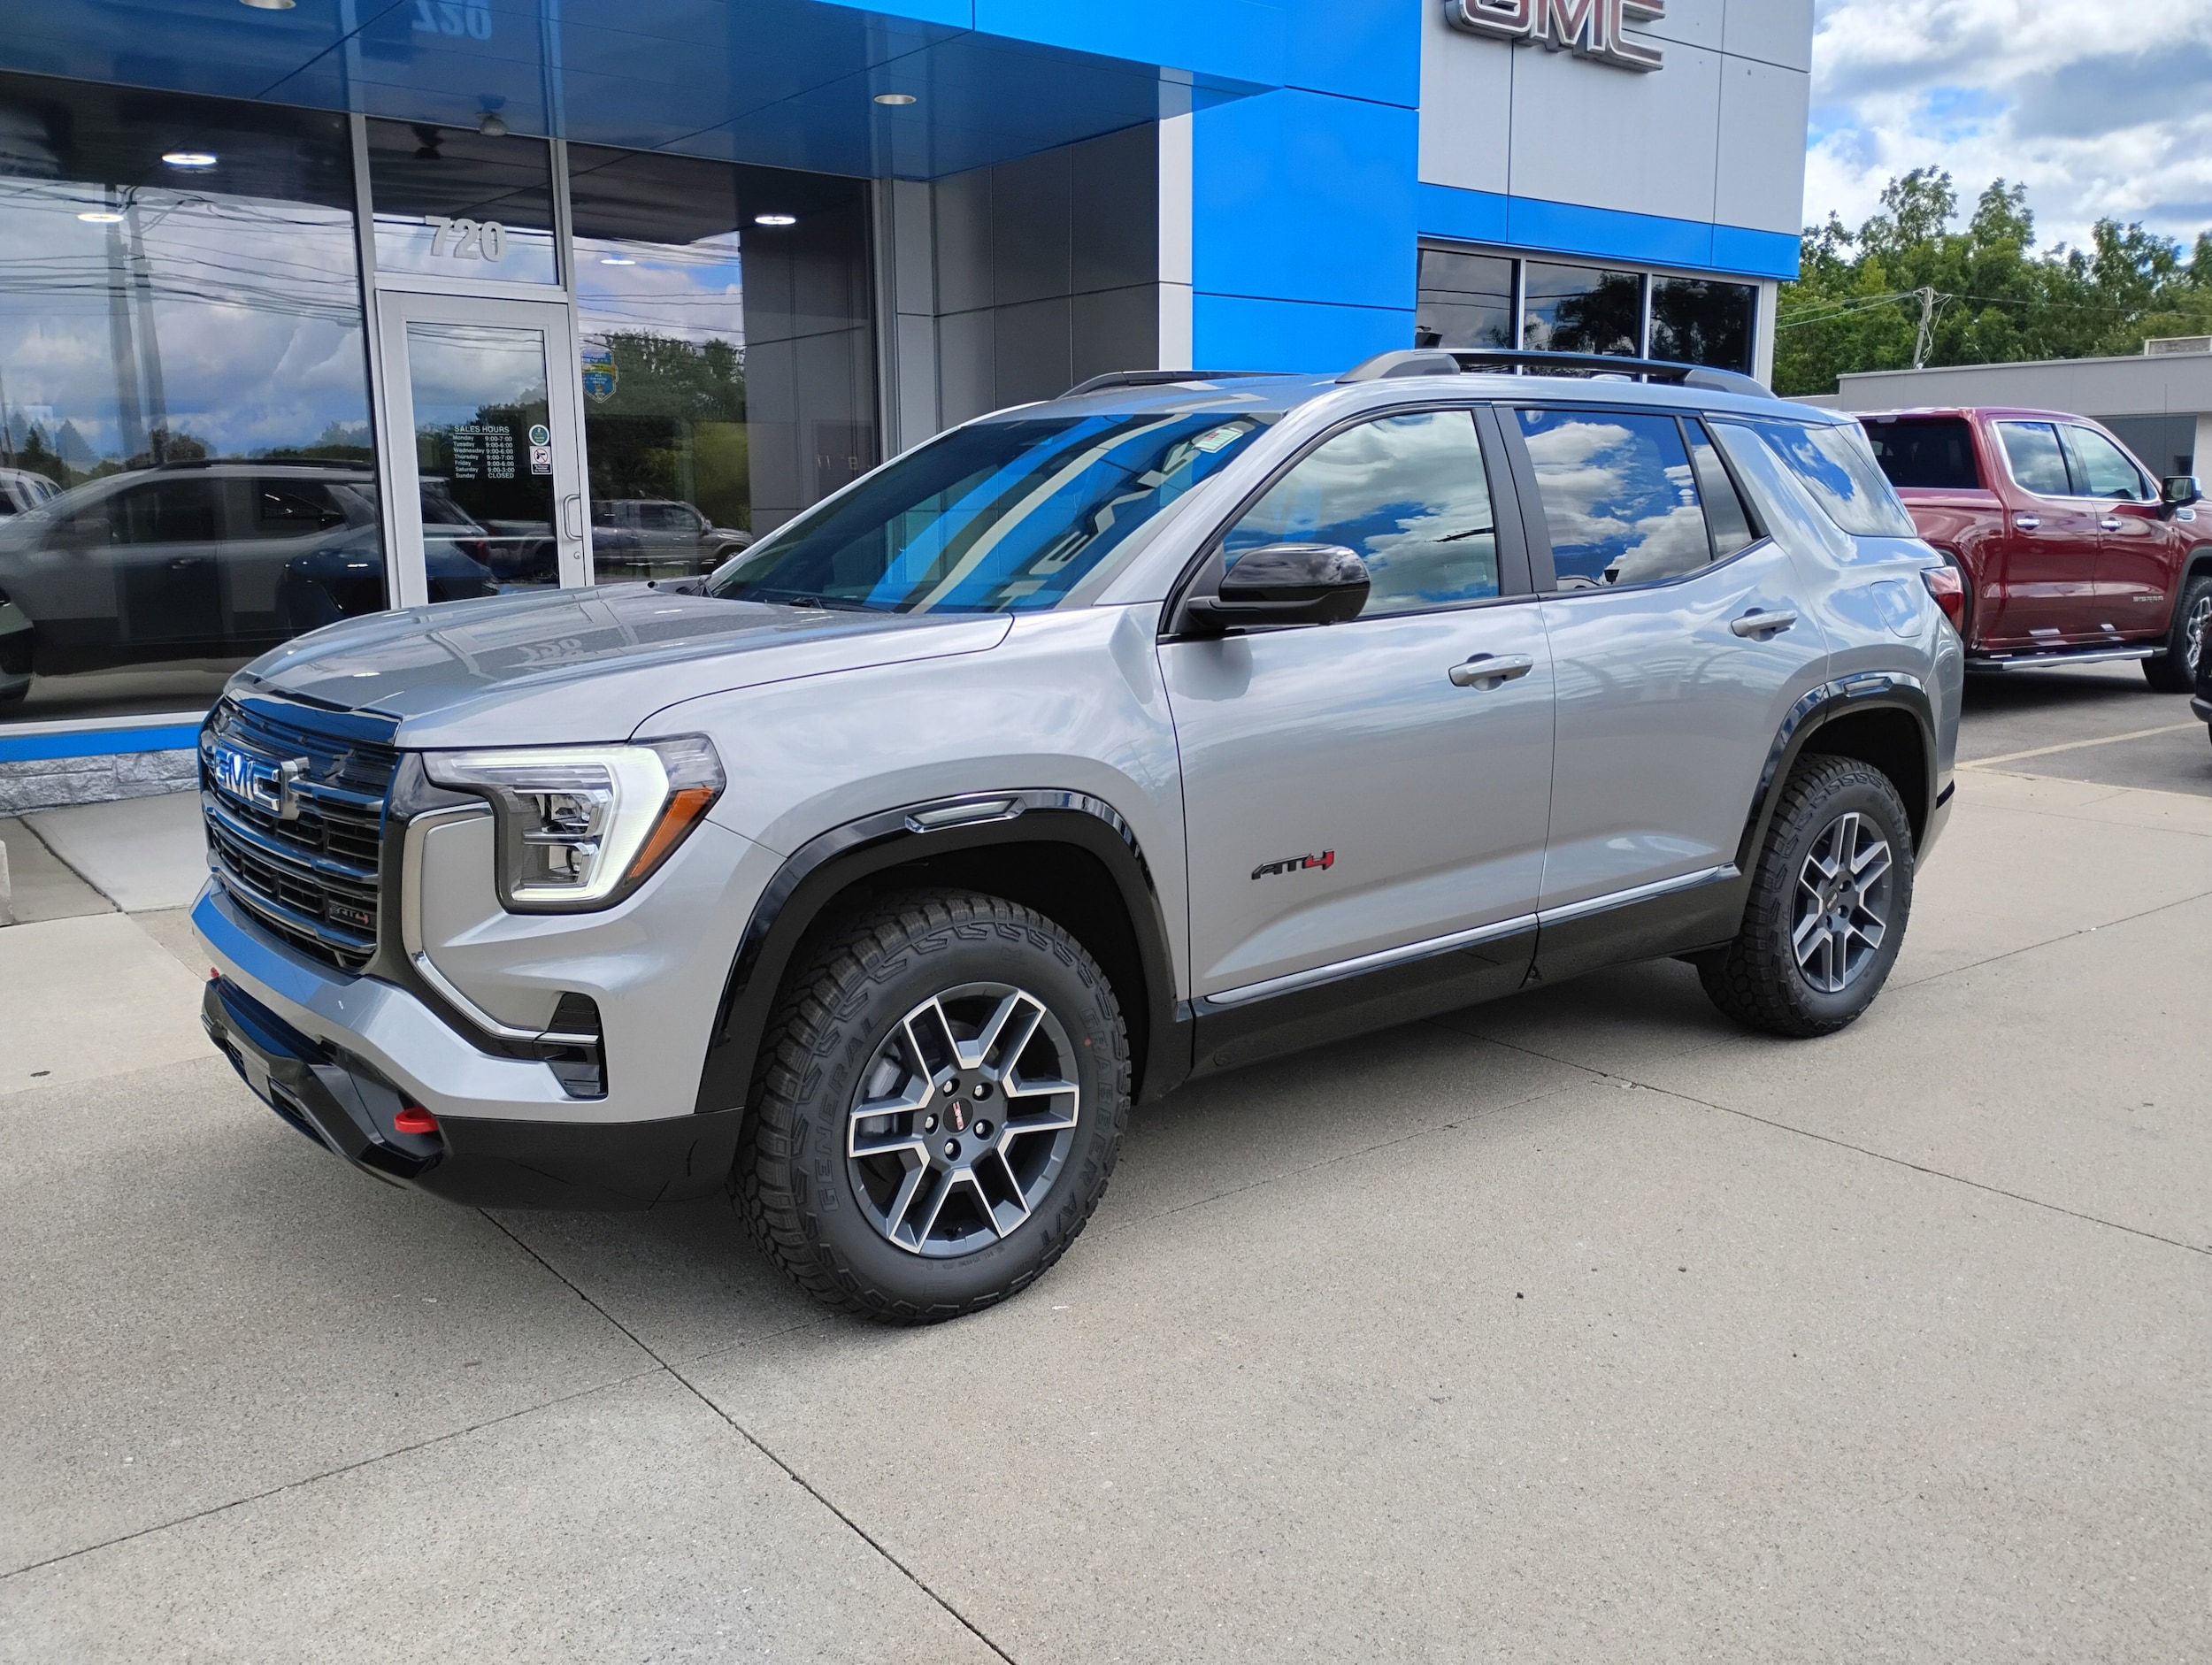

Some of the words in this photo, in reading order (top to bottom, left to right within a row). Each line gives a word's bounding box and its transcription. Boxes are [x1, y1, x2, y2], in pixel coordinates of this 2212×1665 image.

[425, 215, 507, 263] 720
[215, 749, 281, 812] GMC
[1251, 849, 1334, 880] AT4
[337, 907, 369, 925] AT4
[815, 1016, 882, 1212] GENERAL
[1079, 1005, 1114, 1187] GRABBER
[1041, 1192, 1078, 1254] A/T
